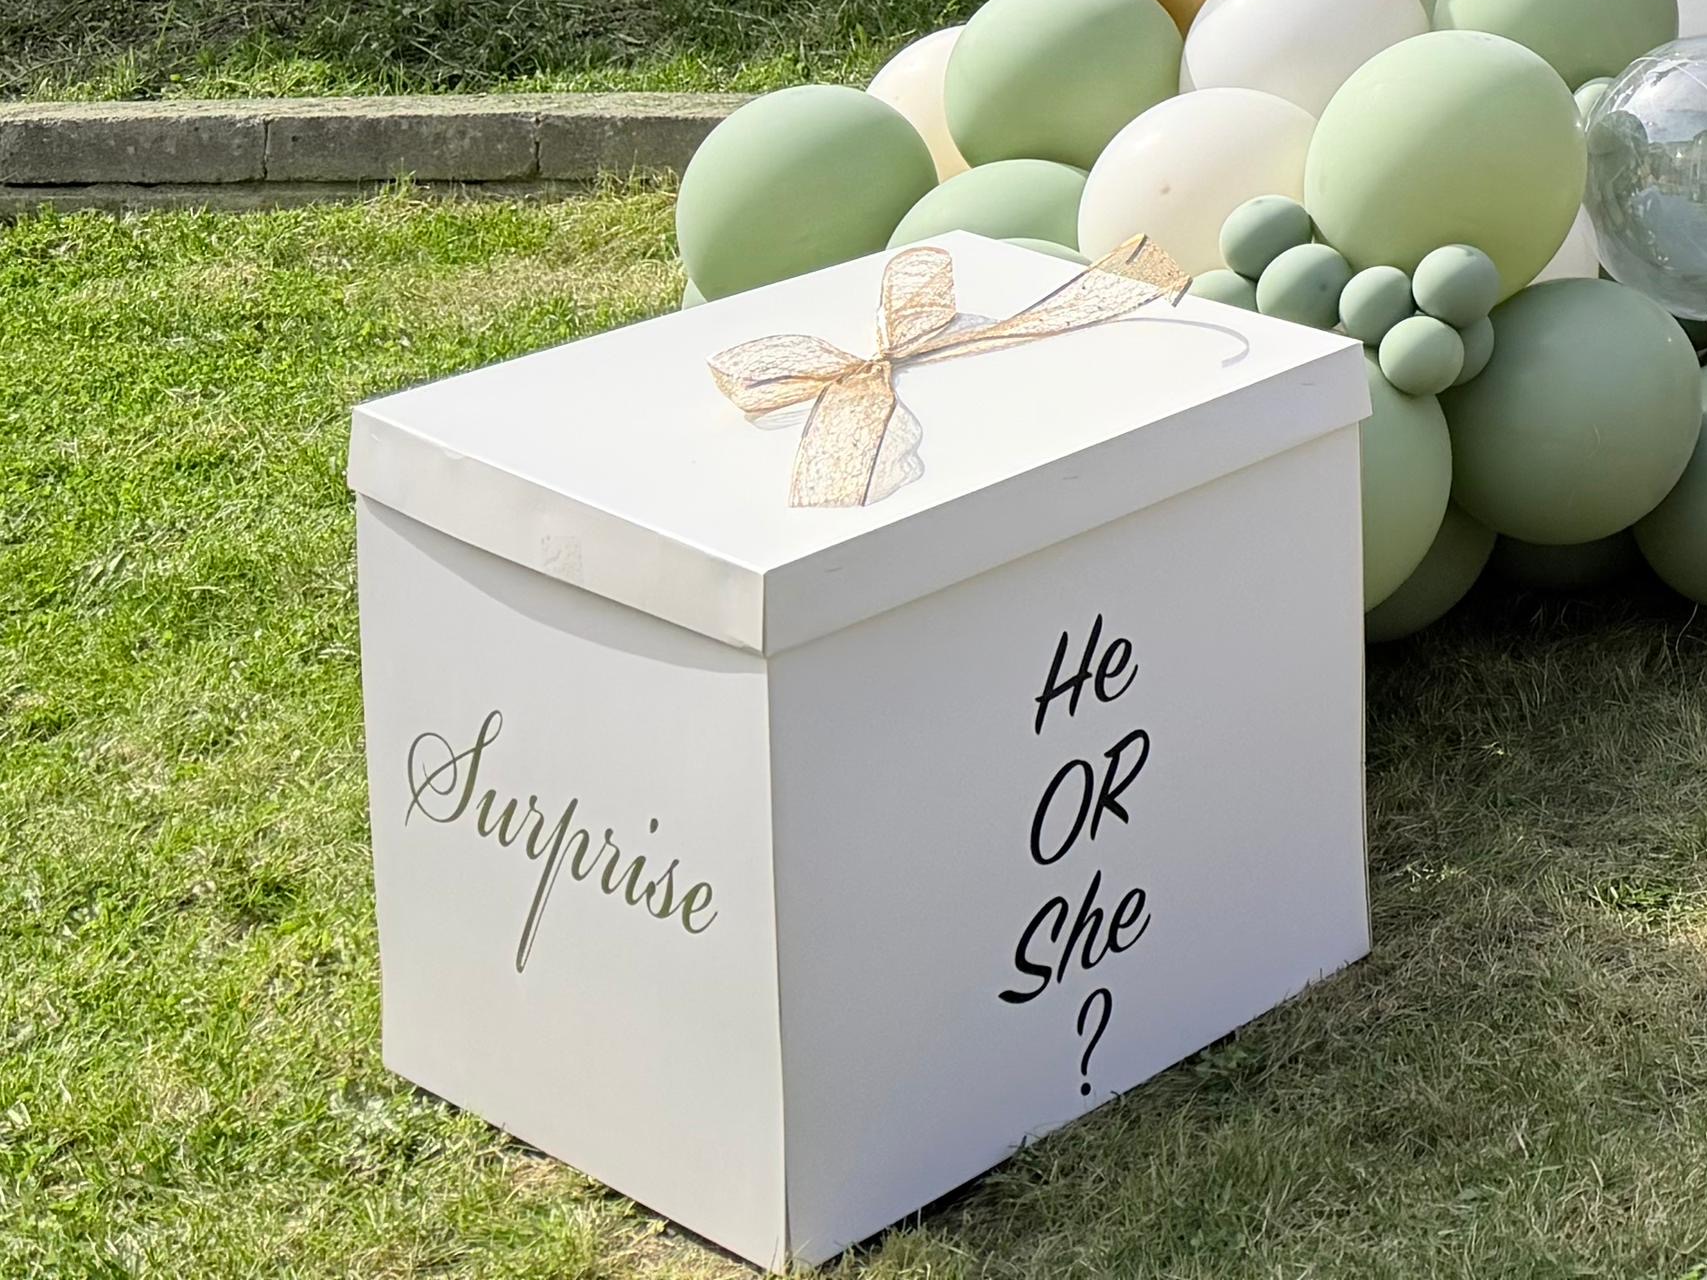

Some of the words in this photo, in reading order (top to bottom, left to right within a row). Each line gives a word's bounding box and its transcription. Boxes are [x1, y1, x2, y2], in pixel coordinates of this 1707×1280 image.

[1034, 613, 1139, 736] He
[404, 709, 719, 973] Surprise
[1030, 729, 1151, 866] OR
[998, 870, 1152, 1005] She
